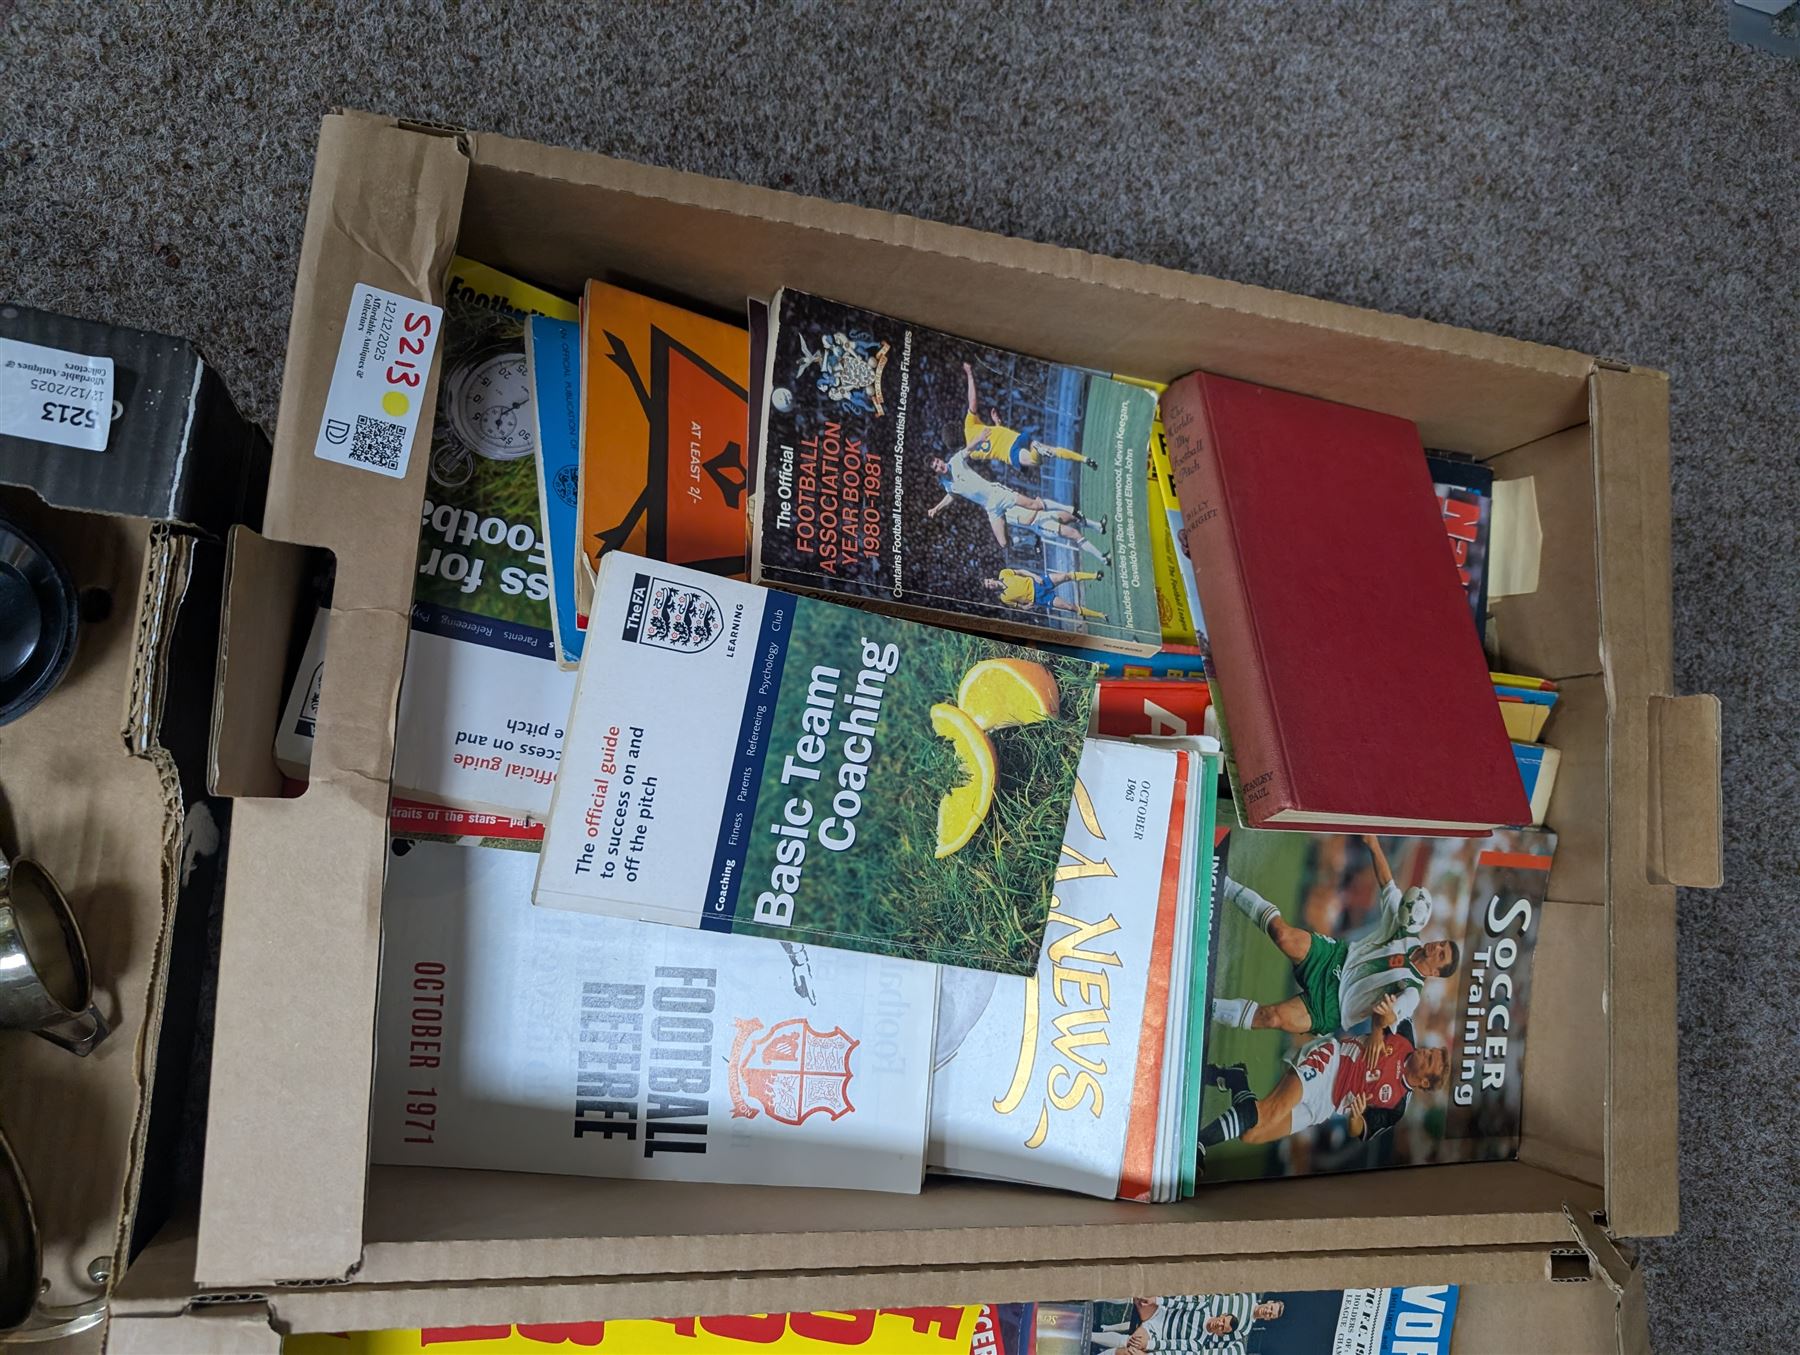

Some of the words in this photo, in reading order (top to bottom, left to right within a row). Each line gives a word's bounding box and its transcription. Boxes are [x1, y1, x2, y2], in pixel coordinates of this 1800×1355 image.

[358, 293, 374, 332] Collectors
[366, 295, 382, 336] Affordable
[374, 300, 397, 362] 12/12/2025
[18, 362, 57, 377] Antiques
[64, 362, 107, 376] Collectors
[359, 335, 373, 373] Antiques
[900, 330, 912, 375] Fixtures
[30, 378, 104, 401] 12/12/2025
[897, 376, 910, 412] League
[41, 401, 99, 429] 5213
[690, 420, 702, 440] AT
[894, 412, 906, 454] Scottish
[1115, 399, 1130, 438] Keegan,
[689, 444, 702, 482] LEAST
[843, 437, 862, 503] BOOK
[894, 454, 904, 474] and
[1113, 437, 1124, 466] Kevin
[1125, 448, 1133, 473] John
[777, 444, 794, 500] Official
[1125, 474, 1133, 498] Elton
[796, 435, 819, 553] FOOTBALL
[819, 421, 842, 574] ASSOCIATION
[893, 474, 905, 513] League
[1114, 466, 1124, 523] Greenwood,
[1126, 499, 1134, 516] and
[776, 501, 791, 530] The
[893, 513, 904, 556] Football
[1115, 523, 1124, 542] Ron
[1126, 517, 1137, 549] Ardiles
[842, 508, 859, 565] YEAR
[1116, 541, 1127, 553] by
[420, 548, 484, 594] for
[893, 556, 903, 598] Contains
[1117, 553, 1130, 590] articles
[1128, 549, 1140, 588] Osvaldo
[441, 615, 493, 638] Refereeing
[1120, 589, 1134, 629] Includes
[503, 630, 539, 647] Parents
[726, 603, 744, 658] LEARNING
[455, 731, 488, 746] and
[493, 738, 514, 751] on
[506, 719, 551, 739] pitch
[628, 726, 644, 759] and
[781, 665, 841, 785] Team
[818, 637, 900, 852] Coaching
[454, 753, 503, 772] guide
[601, 726, 620, 775] guide
[715, 859, 736, 912] Coaching
[728, 812, 744, 846] Fitness
[737, 767, 753, 802] Parents
[747, 705, 767, 756] Refereeing
[758, 641, 780, 695] Psychology
[771, 608, 784, 632] Club
[504, 763, 558, 785] fficial
[623, 763, 637, 786] on
[1125, 778, 1137, 802] 1963
[427, 810, 439, 821] of
[445, 810, 464, 823] the
[585, 779, 609, 838] official
[638, 775, 658, 820] pitch
[1134, 780, 1151, 841] OCTOBER
[608, 790, 631, 856] success
[630, 824, 648, 853] the
[575, 842, 596, 874] The
[600, 861, 616, 879] to
[624, 856, 641, 882] off
[753, 796, 813, 927] Basic
[1482, 895, 1532, 1091] SOCCER
[409, 961, 447, 1069] OCTOBER
[1454, 945, 1492, 1106] Training
[574, 981, 646, 1140] REFEREE
[644, 966, 718, 1158] FOOTBALL
[403, 1087, 438, 1145] 1971
[1340, 1294, 1353, 1329] LEAGUE
[1350, 1294, 1361, 1333] HOLDERS
